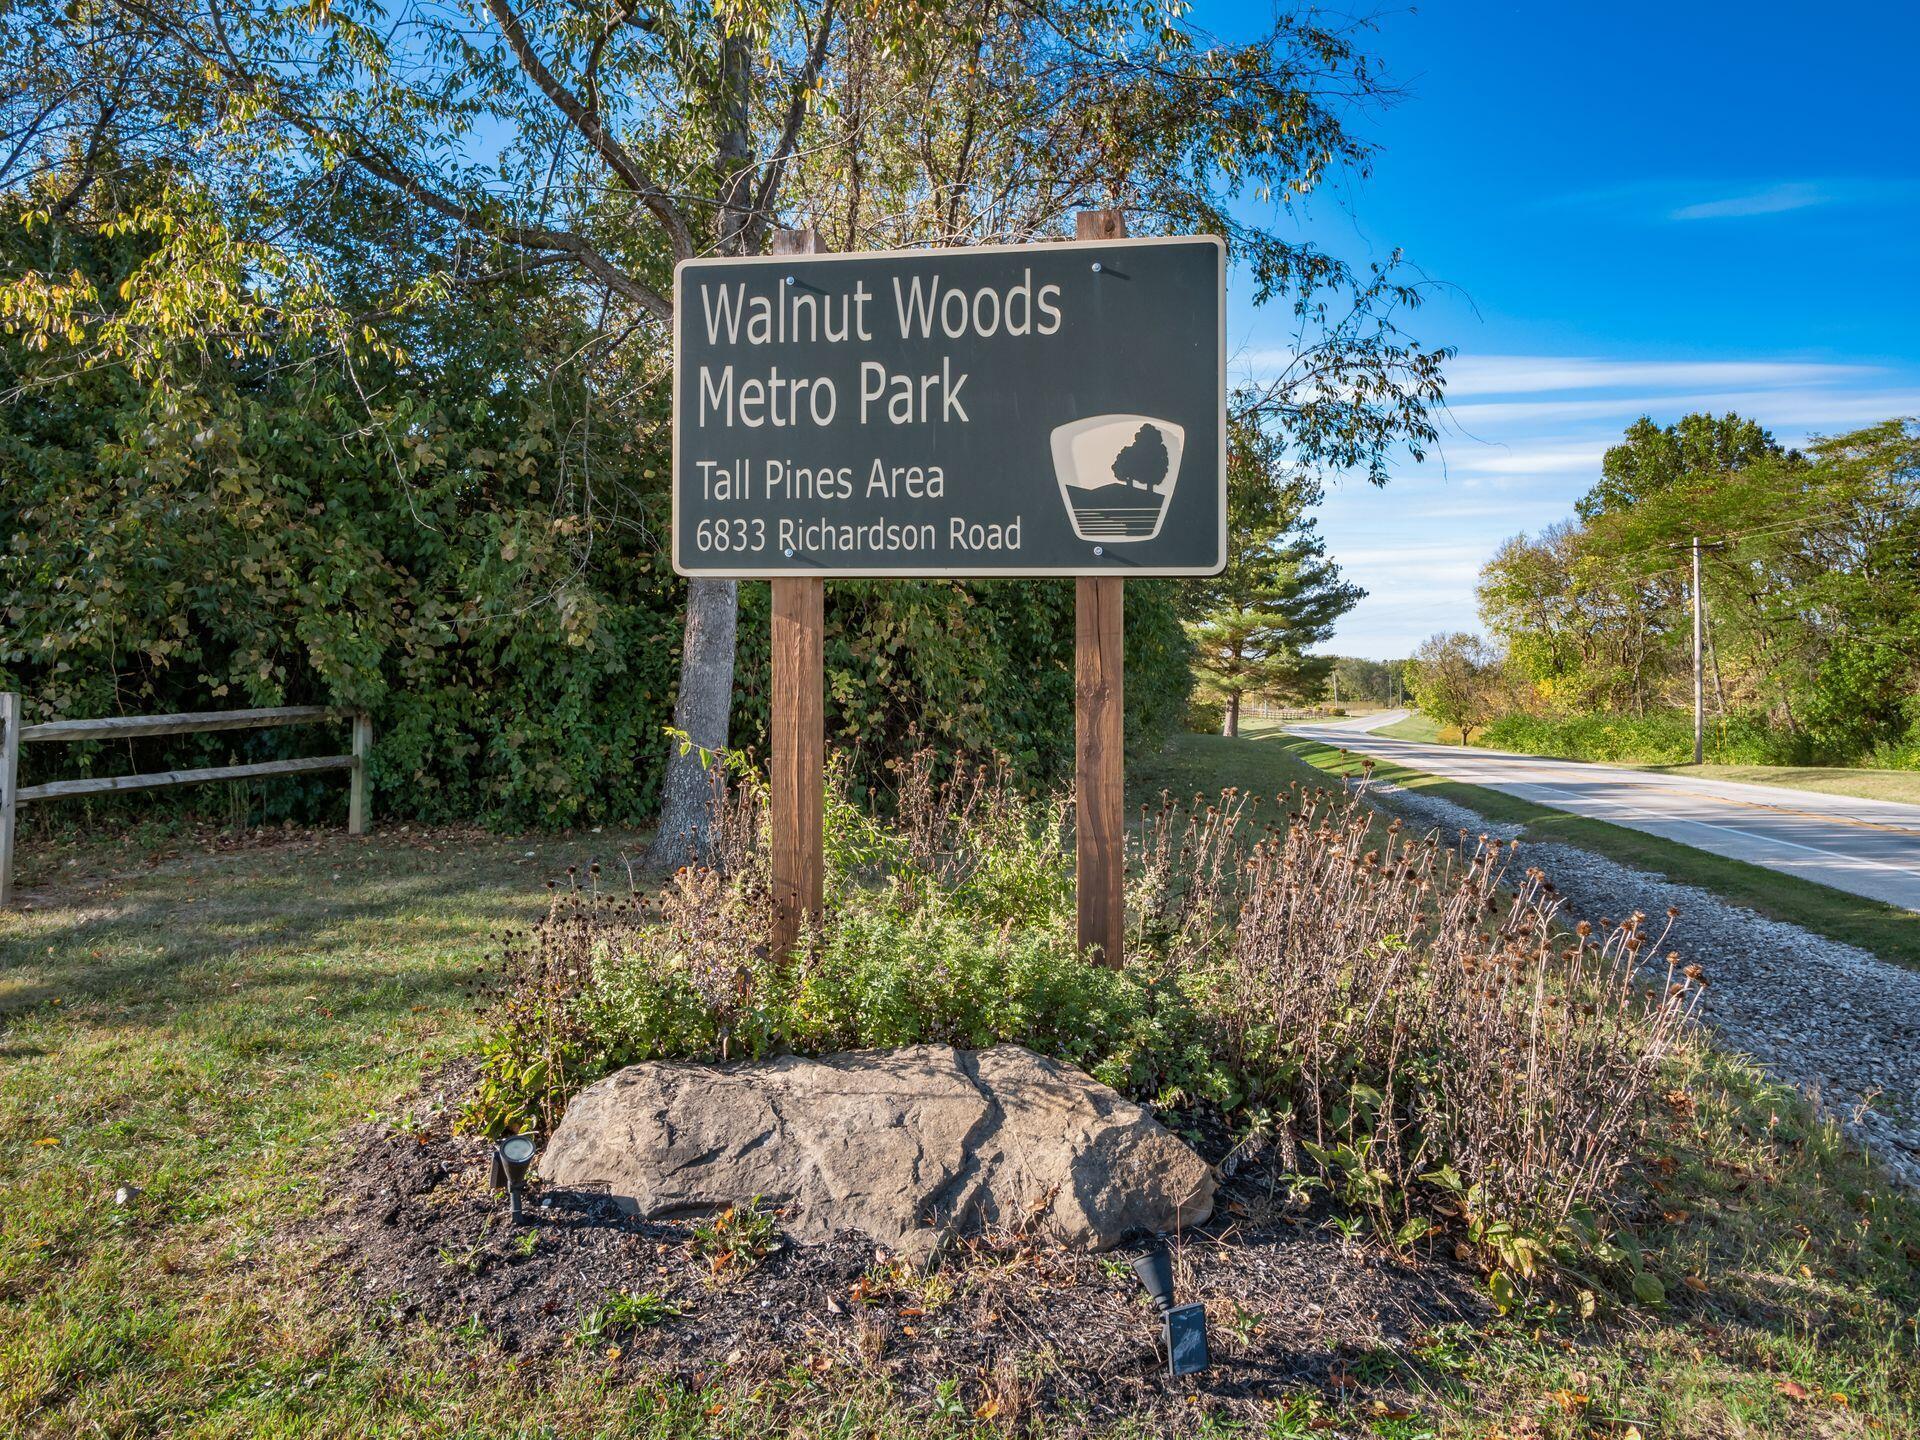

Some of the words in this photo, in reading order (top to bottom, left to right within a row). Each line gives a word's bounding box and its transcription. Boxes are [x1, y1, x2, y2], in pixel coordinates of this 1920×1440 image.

[700, 278, 873, 346] Walnut
[892, 267, 1062, 340] Woods
[699, 365, 837, 428] Metro
[860, 356, 970, 425] Park
[696, 458, 750, 500] Tall
[765, 459, 853, 500] Pines
[866, 458, 944, 499] Area
[696, 518, 766, 552] 6833
[779, 516, 936, 551] Richardson
[950, 515, 1021, 550] Road
